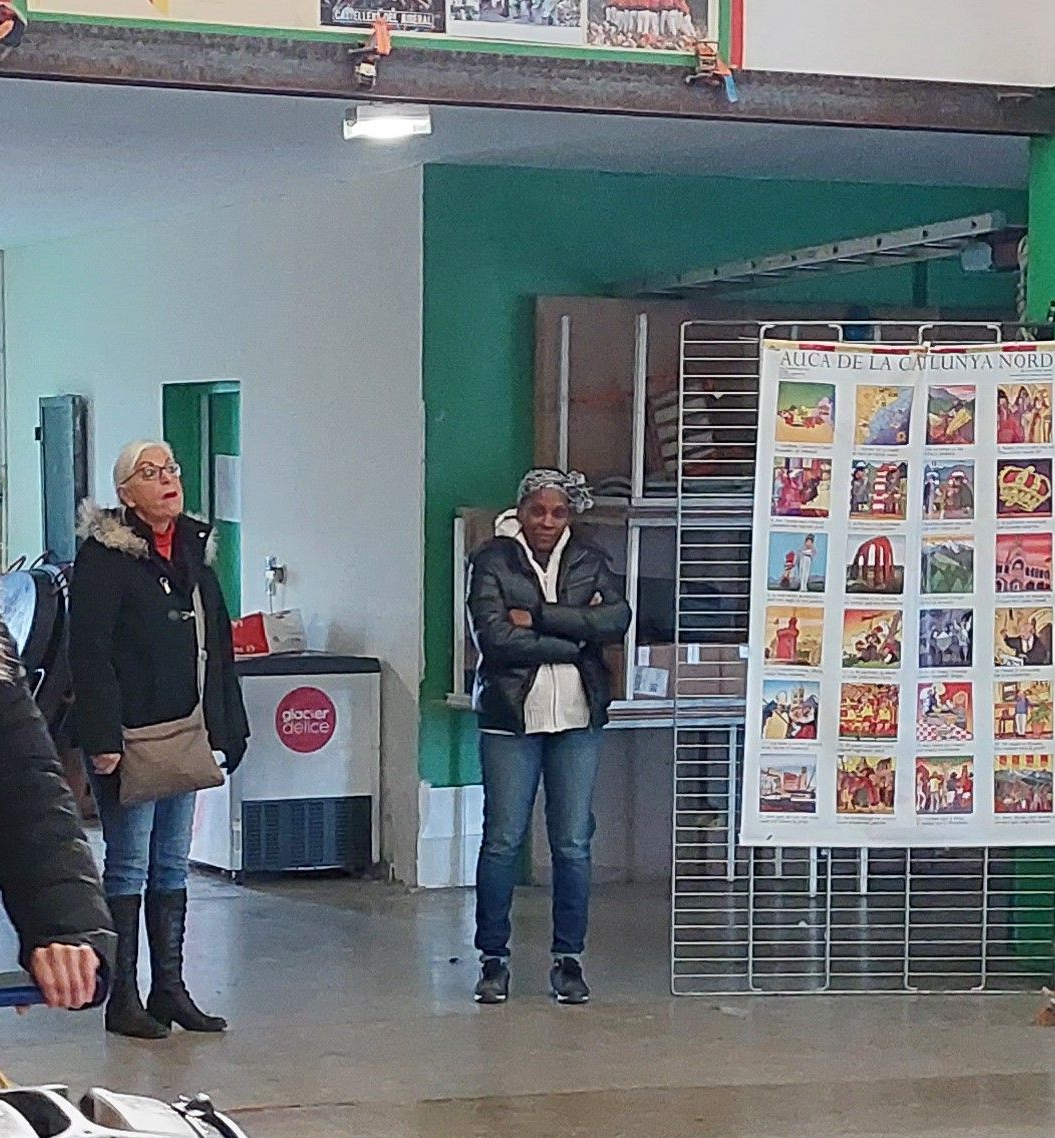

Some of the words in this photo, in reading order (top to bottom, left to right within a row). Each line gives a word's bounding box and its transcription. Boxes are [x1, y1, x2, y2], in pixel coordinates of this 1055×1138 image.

[780, 351, 830, 368] AUCA
[838, 354, 863, 370] DE
[869, 356, 892, 371] LA
[899, 353, 993, 371] CATLUNYA
[999, 353, 1053, 368] NORD
[282, 708, 330, 723] glacier
